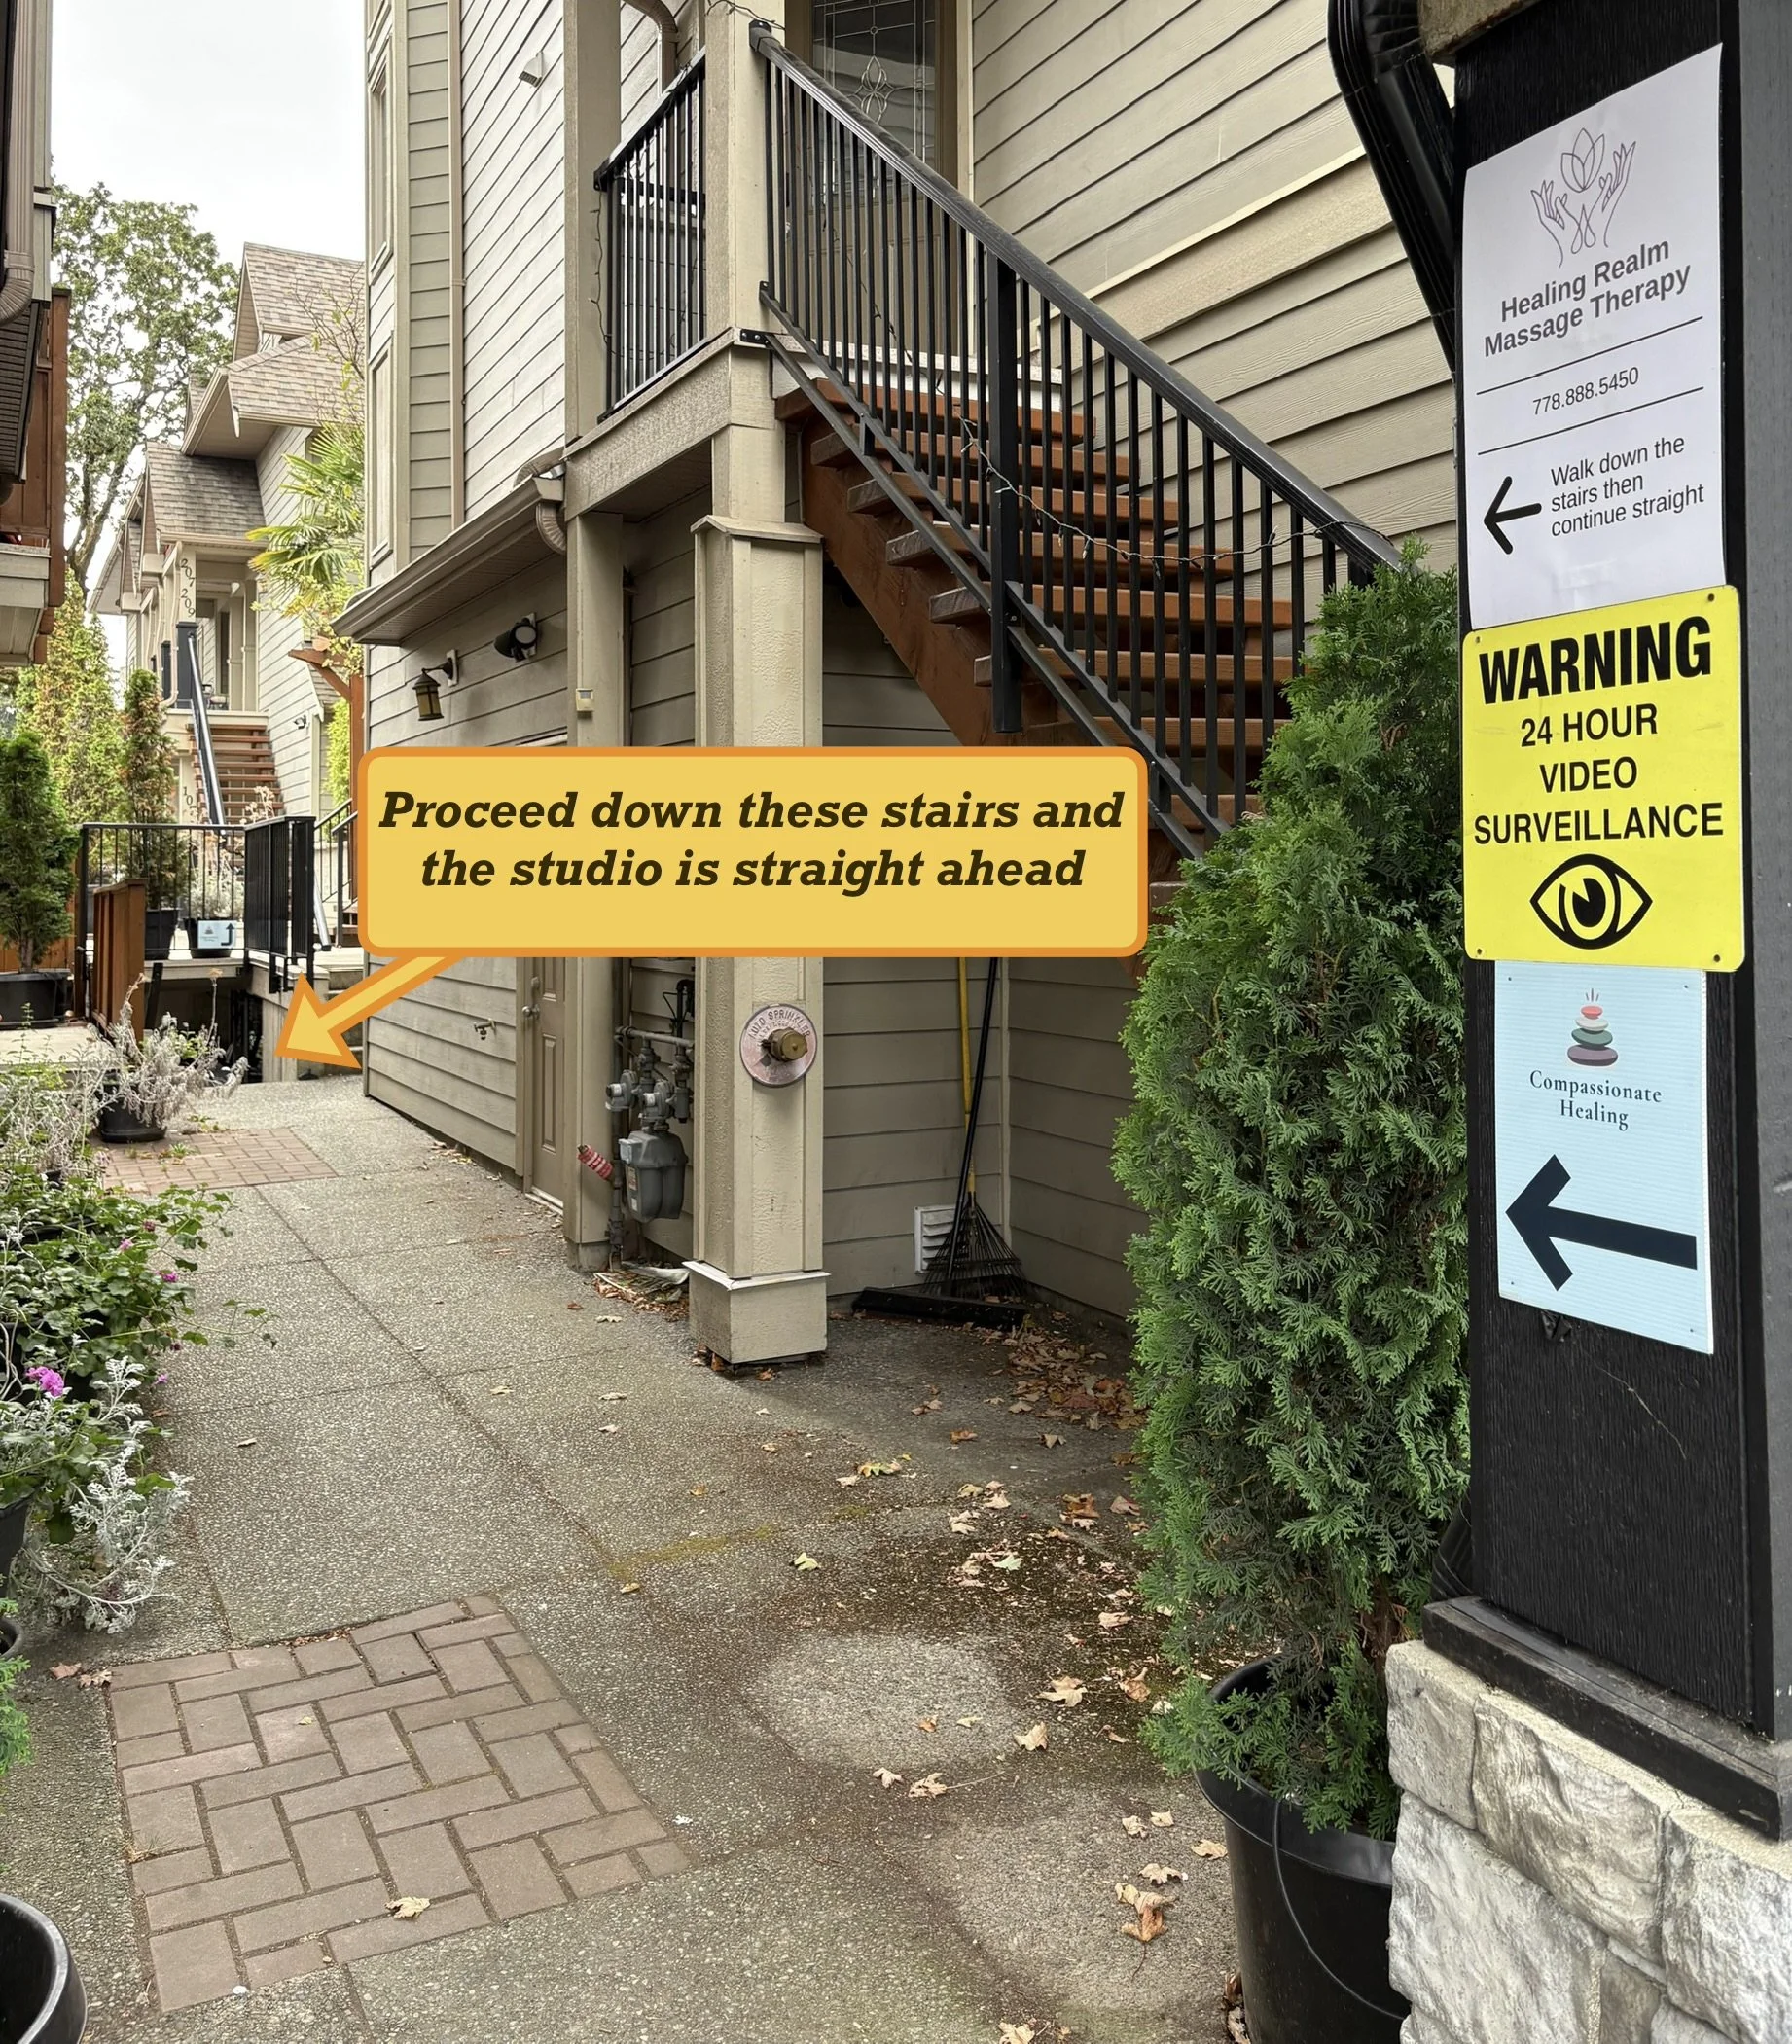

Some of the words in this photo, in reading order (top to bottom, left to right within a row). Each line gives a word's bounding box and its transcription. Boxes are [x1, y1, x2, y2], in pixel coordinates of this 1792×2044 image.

[1501, 273, 1586, 322] Healing
[1594, 240, 1669, 287] Realm
[1485, 305, 1583, 357] Massage
[1590, 265, 1691, 319] Therapy
[1532, 366, 1639, 415] 778.888.5450
[1551, 458, 1594, 487] Walk
[1599, 448, 1648, 474] down
[1654, 436, 1685, 459] the
[1551, 485, 1598, 512] stairs
[1603, 472, 1643, 499] then
[1551, 508, 1627, 537] continue
[1632, 484, 1704, 519] straight
[1479, 615, 1711, 705] WARNING
[1521, 715, 1553, 748] 24
[1563, 703, 1658, 743] HOUR
[1539, 756, 1637, 793] VIDEO
[1474, 802, 1724, 845] SURVEILLANCE
[768, 1009, 811, 1037] SPRINKLER
[1529, 1069, 1662, 1103] Compassionate
[1560, 1099, 1629, 1131] Healing
